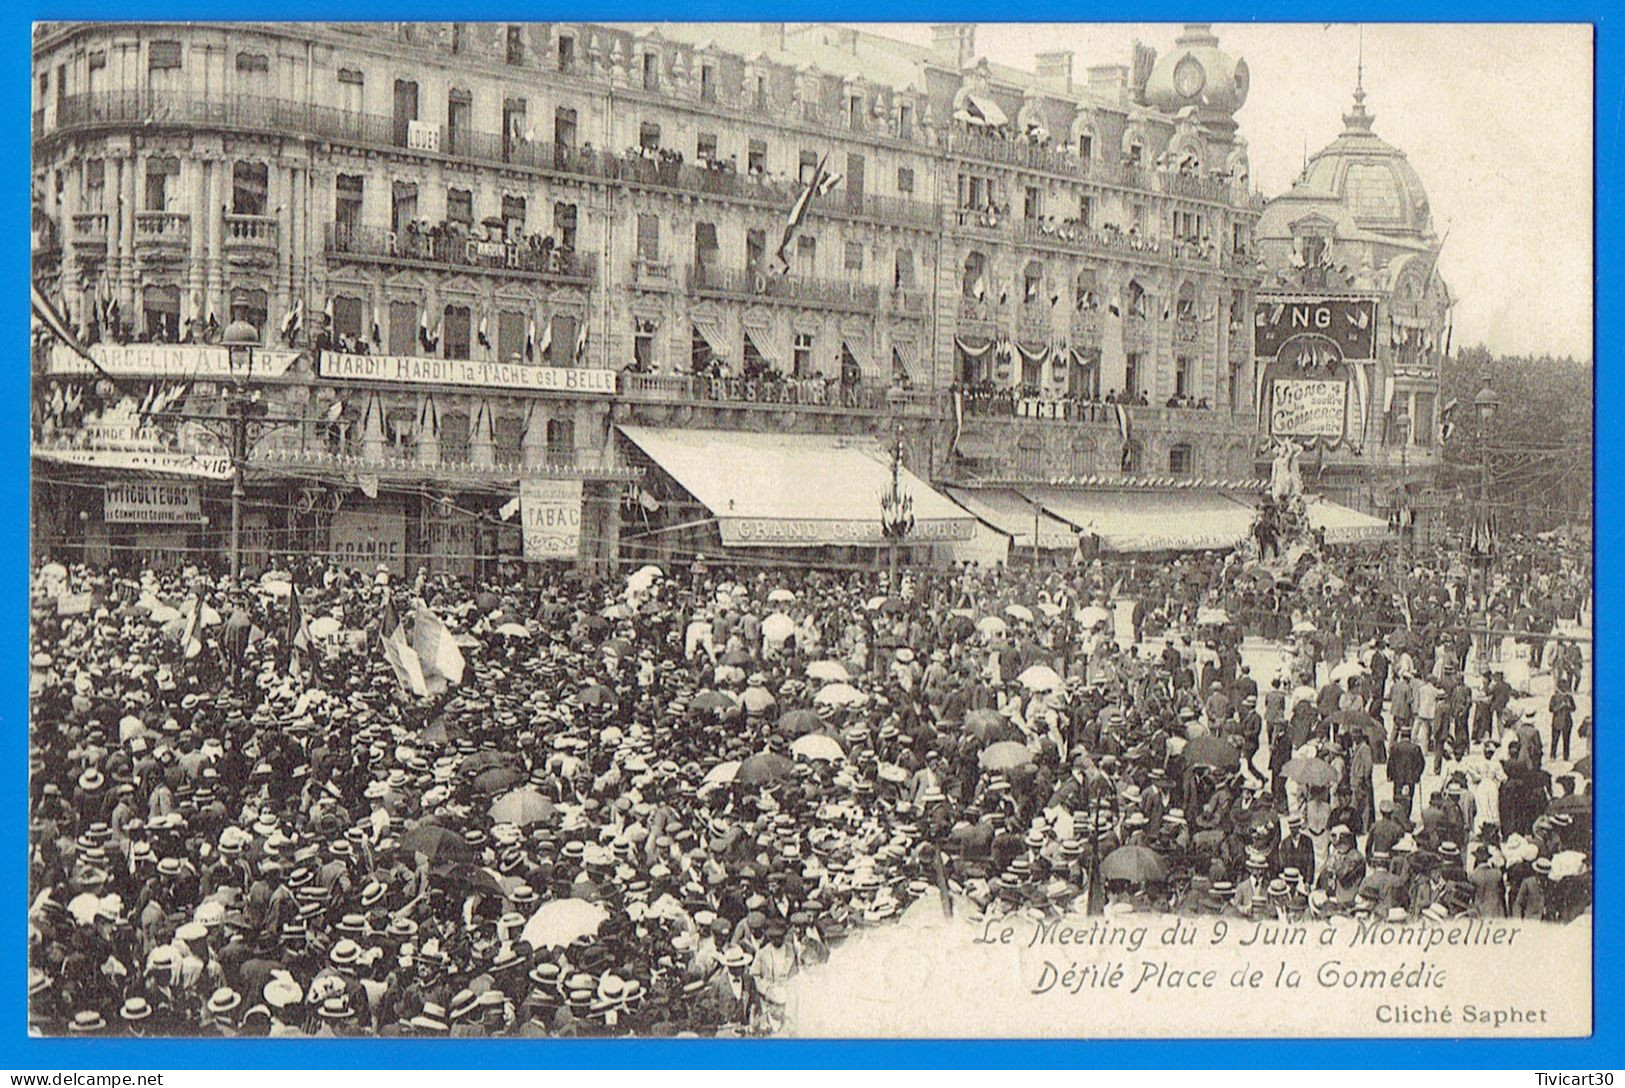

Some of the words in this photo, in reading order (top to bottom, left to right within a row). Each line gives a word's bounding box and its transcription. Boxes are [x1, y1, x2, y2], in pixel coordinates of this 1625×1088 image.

[395, 358, 454, 382] HARDI!
[566, 369, 612, 389] BELLE
[529, 508, 579, 527] TABAC
